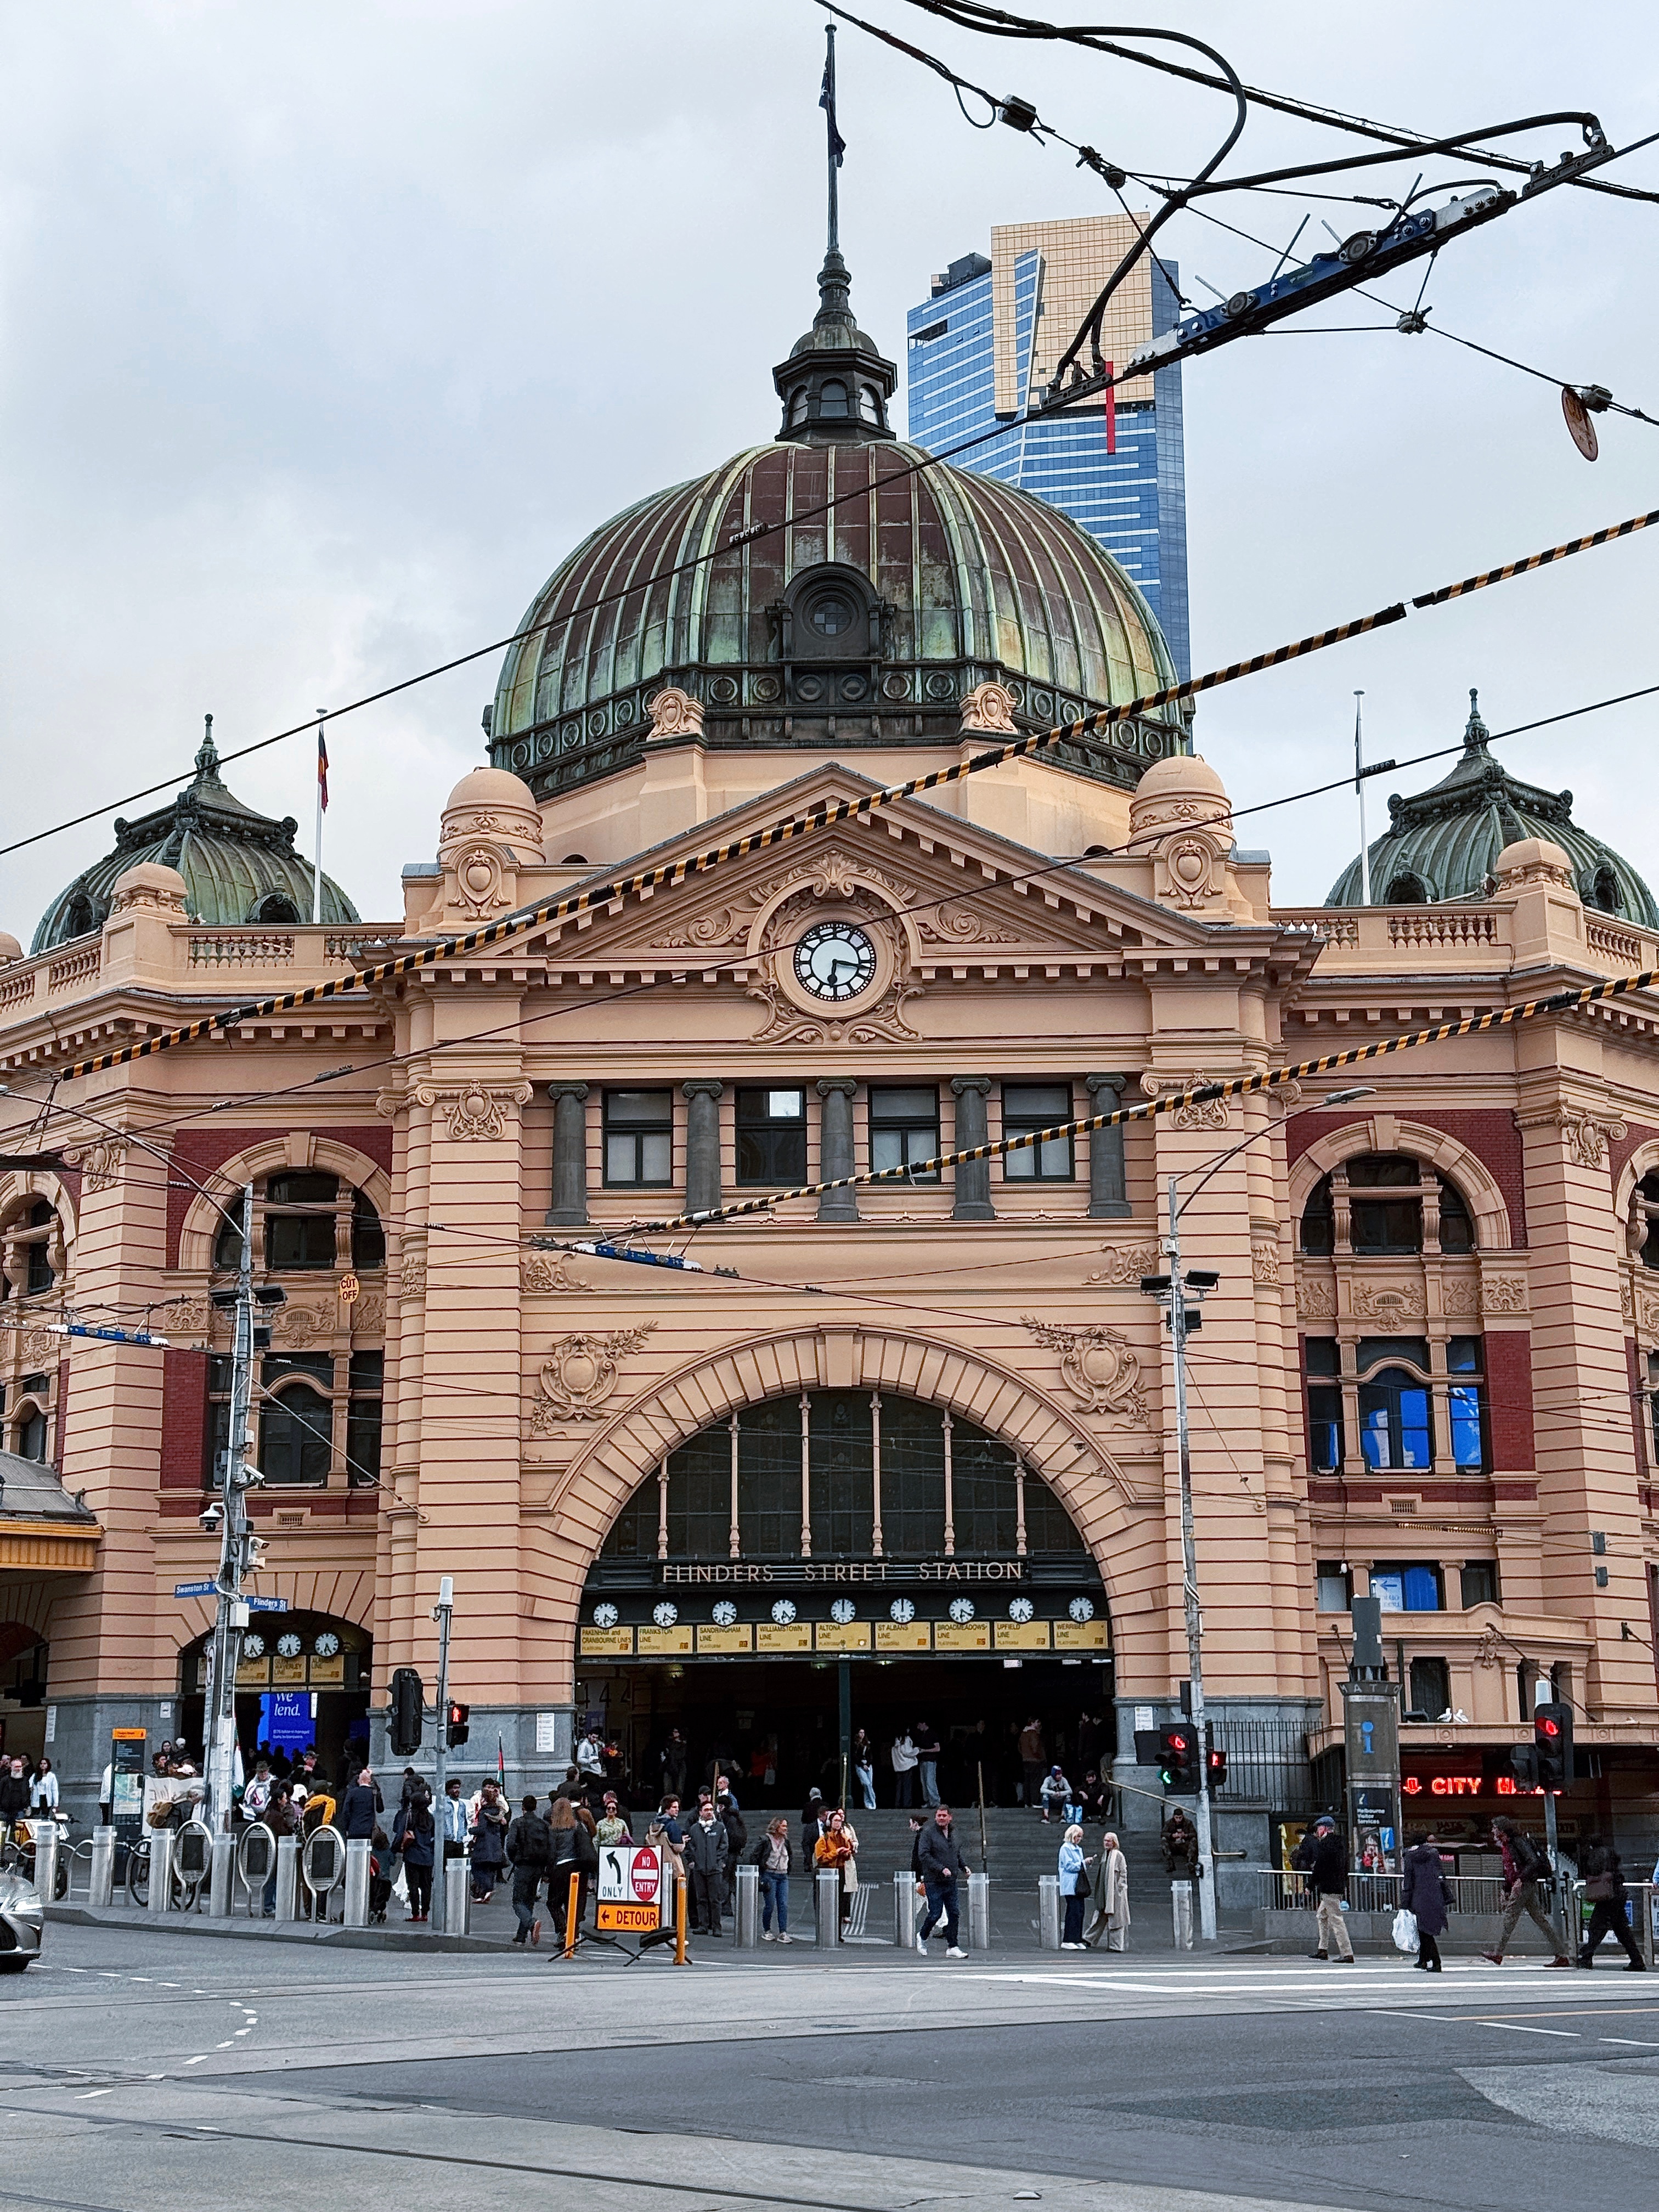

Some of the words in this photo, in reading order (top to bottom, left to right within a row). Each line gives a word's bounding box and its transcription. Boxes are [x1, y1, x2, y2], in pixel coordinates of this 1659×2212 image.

[341, 1278, 356, 1289] CUT
[342, 1290, 357, 1300] OFF
[663, 1565, 773, 1583] FLINDERS
[805, 1564, 889, 1582] STREET
[919, 1562, 1022, 1579] STATION
[177, 1584, 202, 1594] Swanston
[253, 1597, 277, 1608] Flinders
[274, 1703, 300, 1716] lend.
[1432, 1778, 1481, 1794] CITY
[641, 1856, 651, 1867] NO
[602, 1886, 623, 1898] ONLY
[635, 1882, 656, 1893] ENTRY
[617, 1910, 657, 1926] DETOUR
